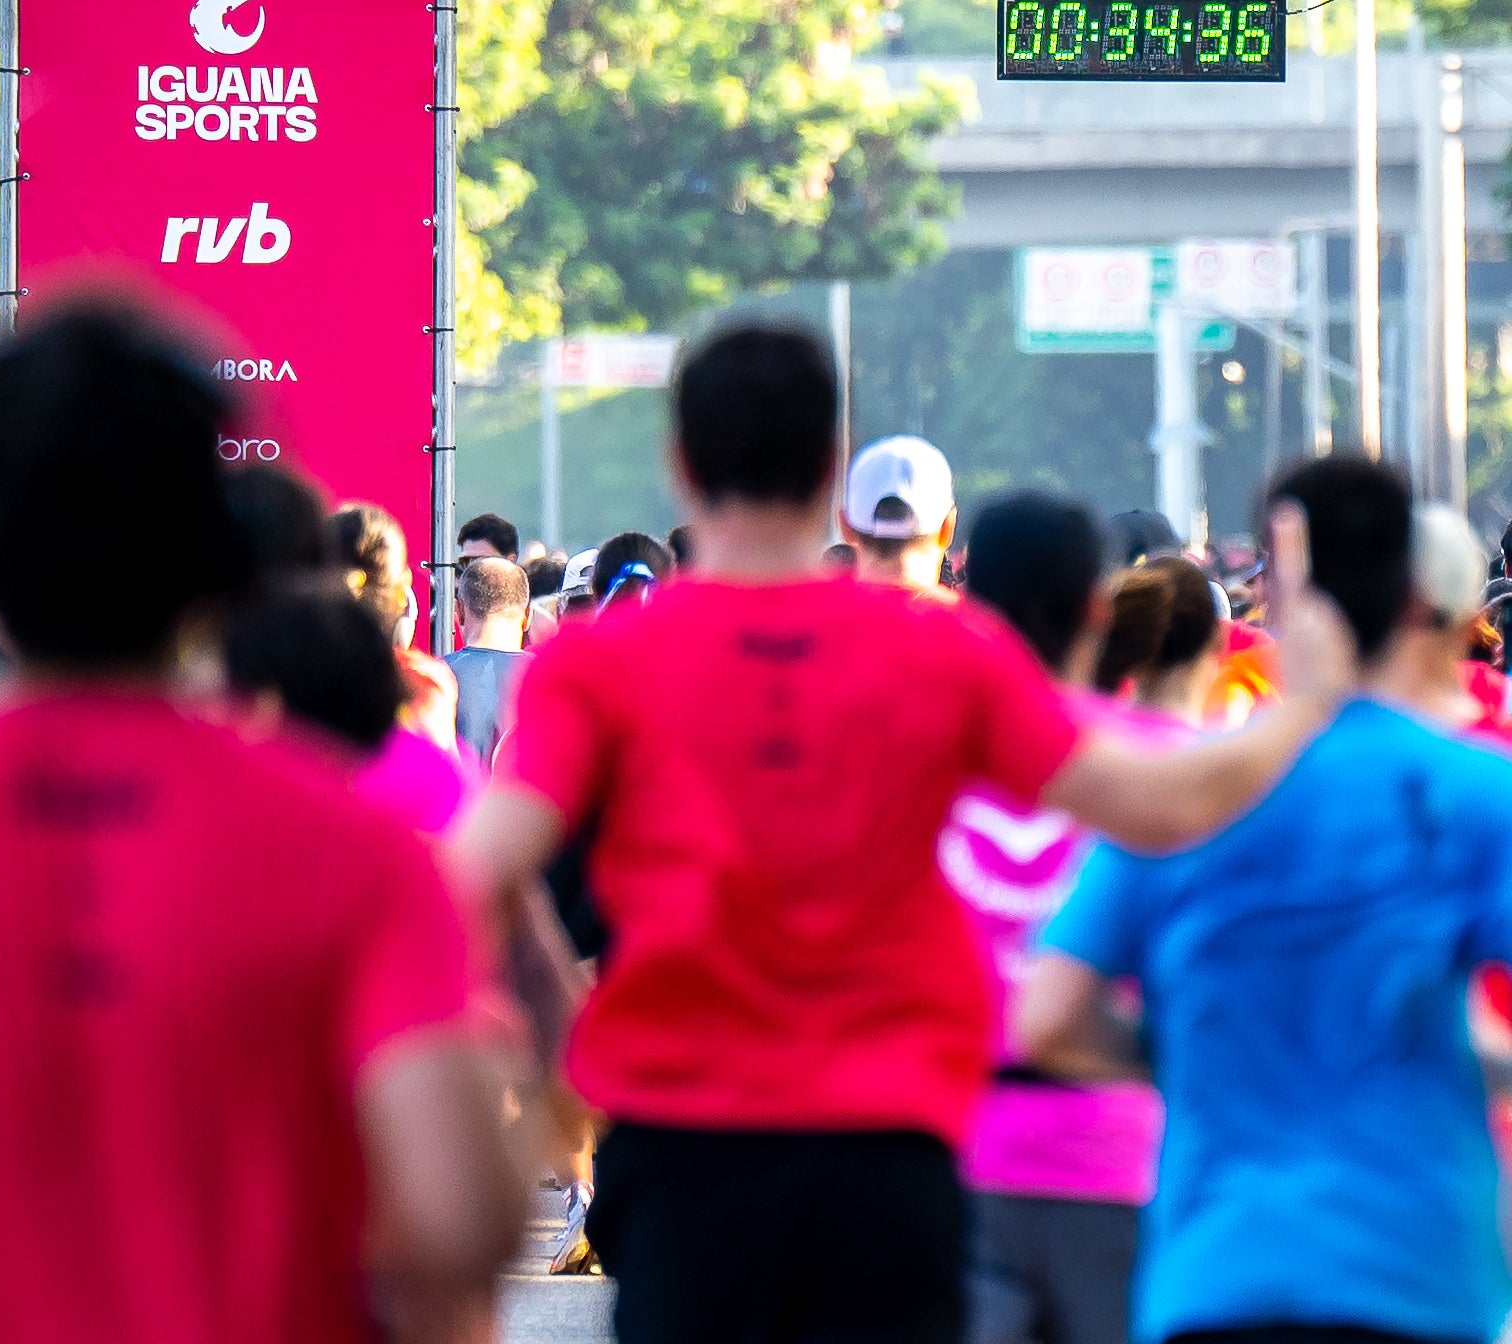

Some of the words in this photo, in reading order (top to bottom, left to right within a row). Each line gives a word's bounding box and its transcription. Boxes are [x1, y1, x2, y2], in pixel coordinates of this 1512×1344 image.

[1007, 2, 1270, 62] 00:34:36
[137, 66, 318, 103] IGUANA
[134, 105, 317, 142] SPORTS
[160, 202, 292, 264] rvb
